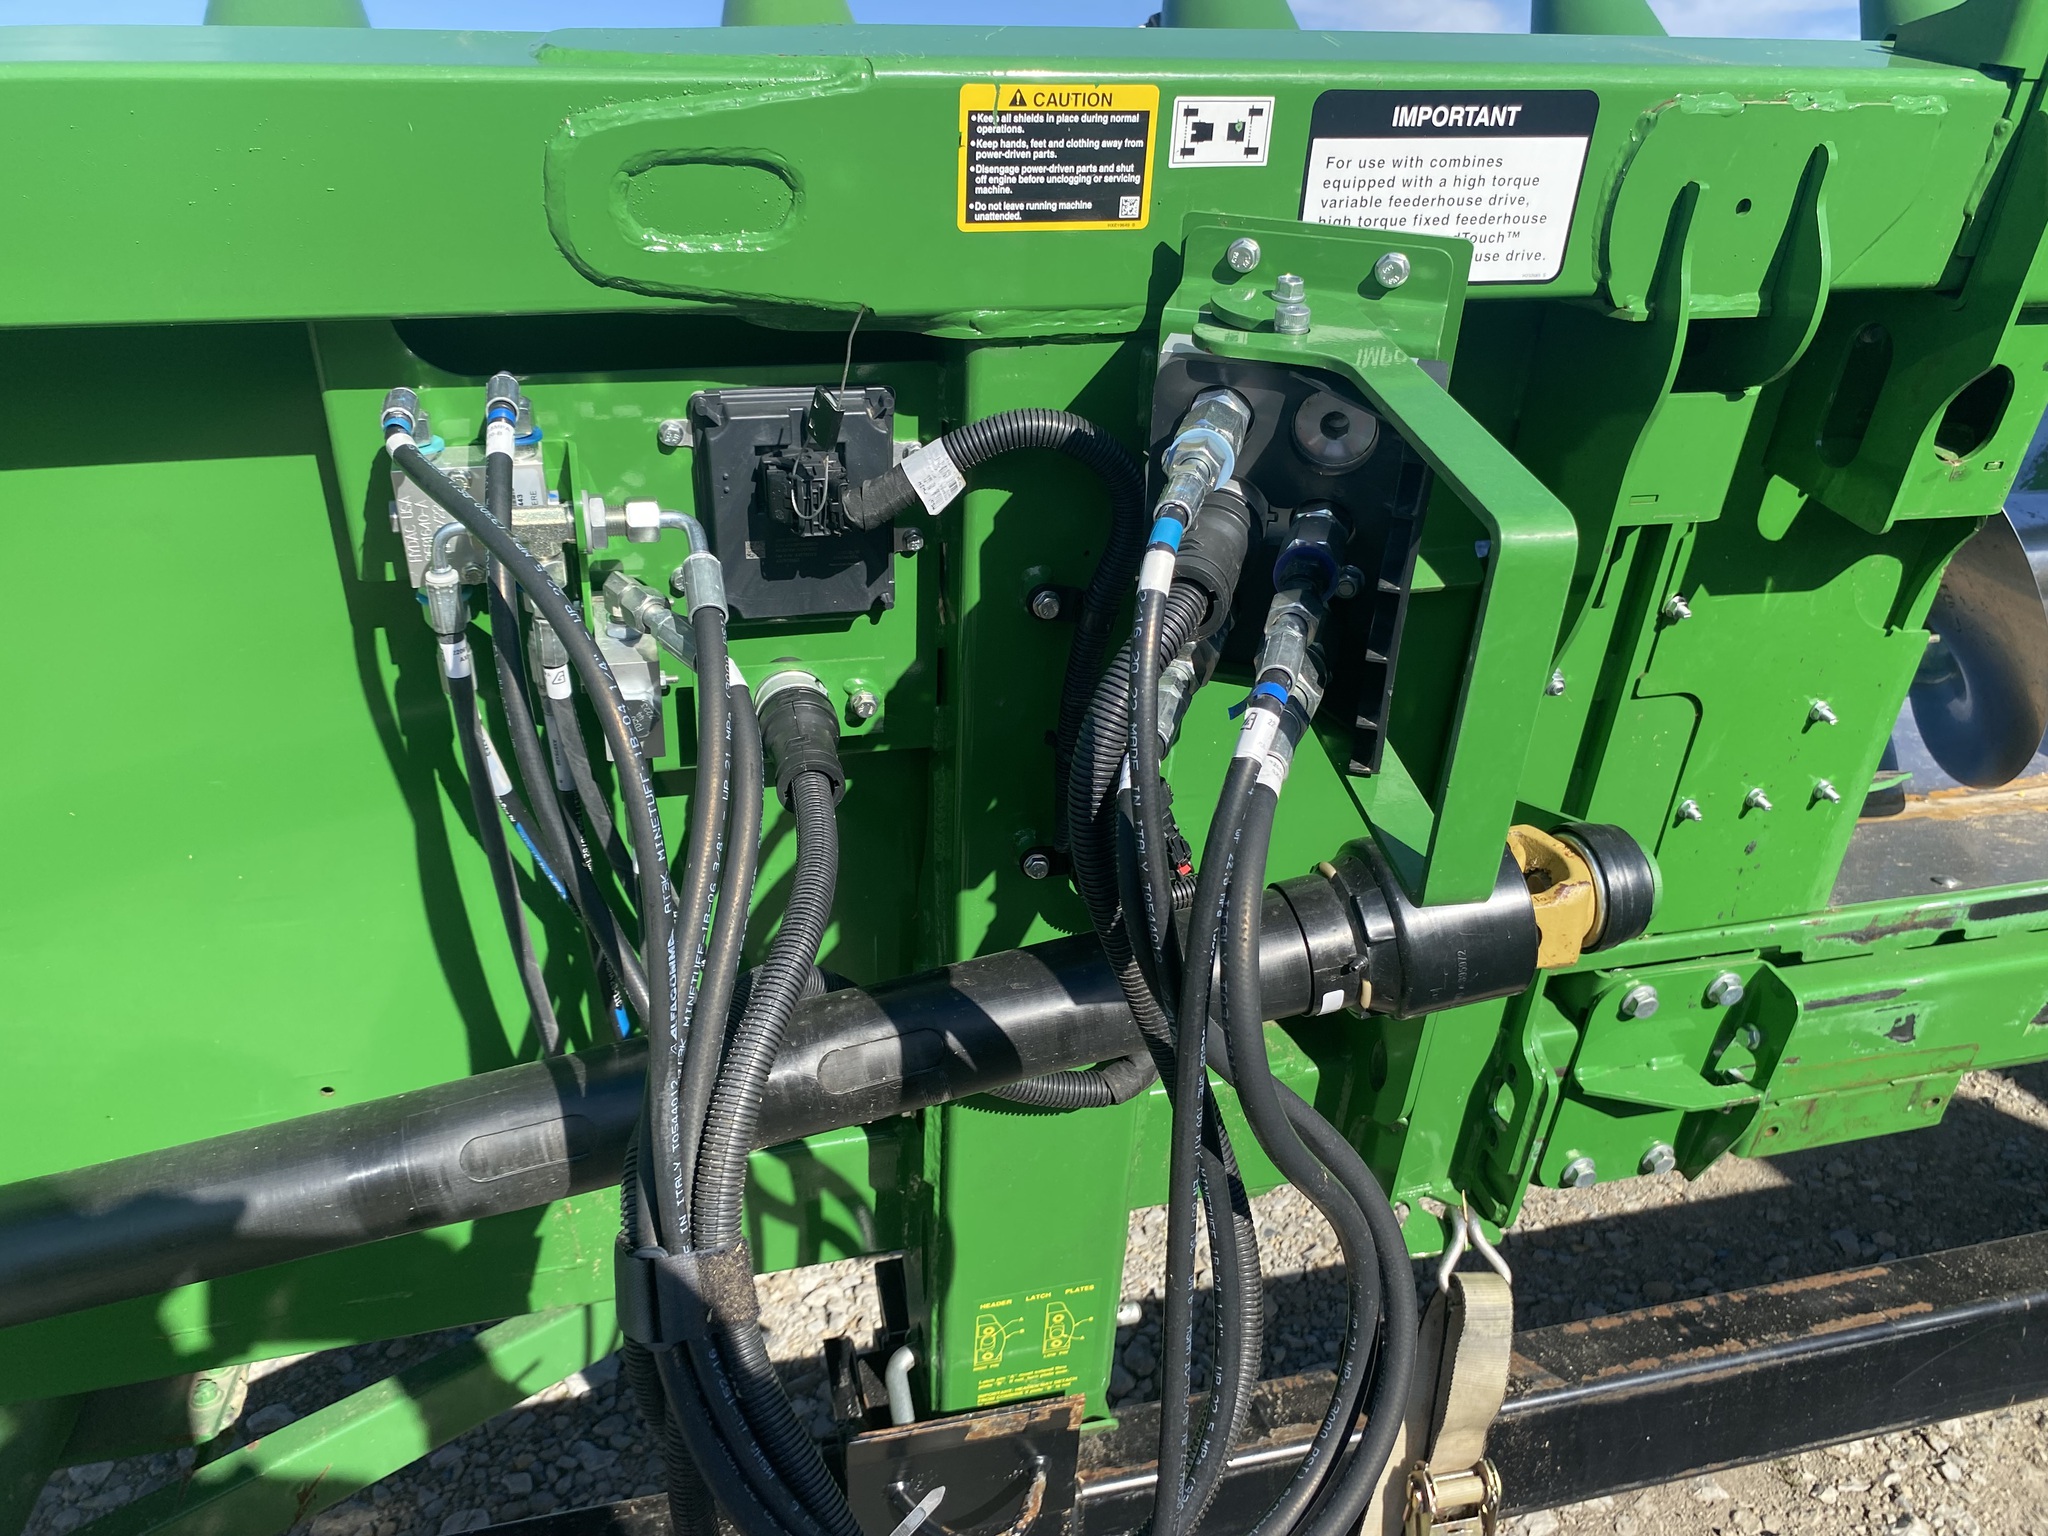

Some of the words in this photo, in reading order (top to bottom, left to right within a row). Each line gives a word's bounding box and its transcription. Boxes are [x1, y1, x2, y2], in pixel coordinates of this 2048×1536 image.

[1033, 92, 1114, 107] CAUTION
[976, 113, 1000, 125] Keep
[1001, 113, 1012, 122] all
[1013, 112, 1045, 123] shields
[1046, 112, 1055, 122] in
[1056, 113, 1080, 125] place
[1080, 112, 1109, 125] during
[1110, 112, 1140, 123] normal
[1391, 104, 1523, 128] IMPORTANT
[976, 124, 1025, 135] operations.
[976, 138, 999, 150] Keep
[999, 138, 1029, 149] hands,
[1030, 138, 1047, 148] feet
[1048, 138, 1065, 148] and
[1065, 138, 1100, 150] clothing
[1101, 139, 1123, 150] away
[1124, 137, 1144, 148] from
[975, 149, 1031, 160] power-driven
[1033, 149, 1057, 160] parts.
[1326, 156, 1353, 169] For
[1358, 158, 1386, 169] use
[1392, 155, 1424, 169] with
[1429, 155, 1504, 169] combines
[975, 164, 1020, 175] Disengage
[1020, 163, 1074, 174] power-driven
[1076, 163, 1098, 174] parts
[1098, 163, 1115, 173] and
[1115, 162, 1135, 173] shut
[974, 174, 987, 184] off
[988, 175, 1017, 186] engine
[1018, 174, 1045, 184] before
[1046, 174, 1092, 185] unclogging
[1093, 174, 1103, 183] or
[1103, 173, 1141, 185] servicing
[1322, 175, 1396, 192] equipped
[1401, 175, 1433, 189] with
[1438, 178, 1447, 188] a
[1452, 175, 1486, 191] high
[1491, 175, 1540, 191] torque
[974, 185, 1013, 195] machine.
[974, 201, 987, 211] Do
[988, 201, 1002, 211] not
[1003, 201, 1025, 211] leave
[1025, 201, 1058, 212] running
[1058, 200, 1093, 210] machine
[1320, 195, 1383, 209] variable
[1388, 195, 1483, 208] feederhouse
[1488, 194, 1531, 209] drive,
[974, 211, 1022, 221] unattended.
[1357, 215, 1407, 230] torque
[1413, 213, 1450, 227] fixed
[1455, 212, 1548, 226] feederhouse
[1505, 250, 1547, 262] drive.
[529, 490, 538, 506] ERE
[397, 495, 413, 519] USA
[404, 525, 423, 563] HYDAC
[592, 653, 619, 692] 1/4"
[725, 710, 733, 742] MPa
[1128, 722, 1140, 772] MADE
[1131, 784, 1143, 807] IN
[1133, 814, 1150, 873] ITALY
[672, 1162, 686, 1207] ITALY
[678, 1215, 689, 1235] IN
[980, 1299, 1012, 1310] HEADER
[1026, 1292, 1052, 1302] LATCH
[1065, 1285, 1095, 1295] PLATES
